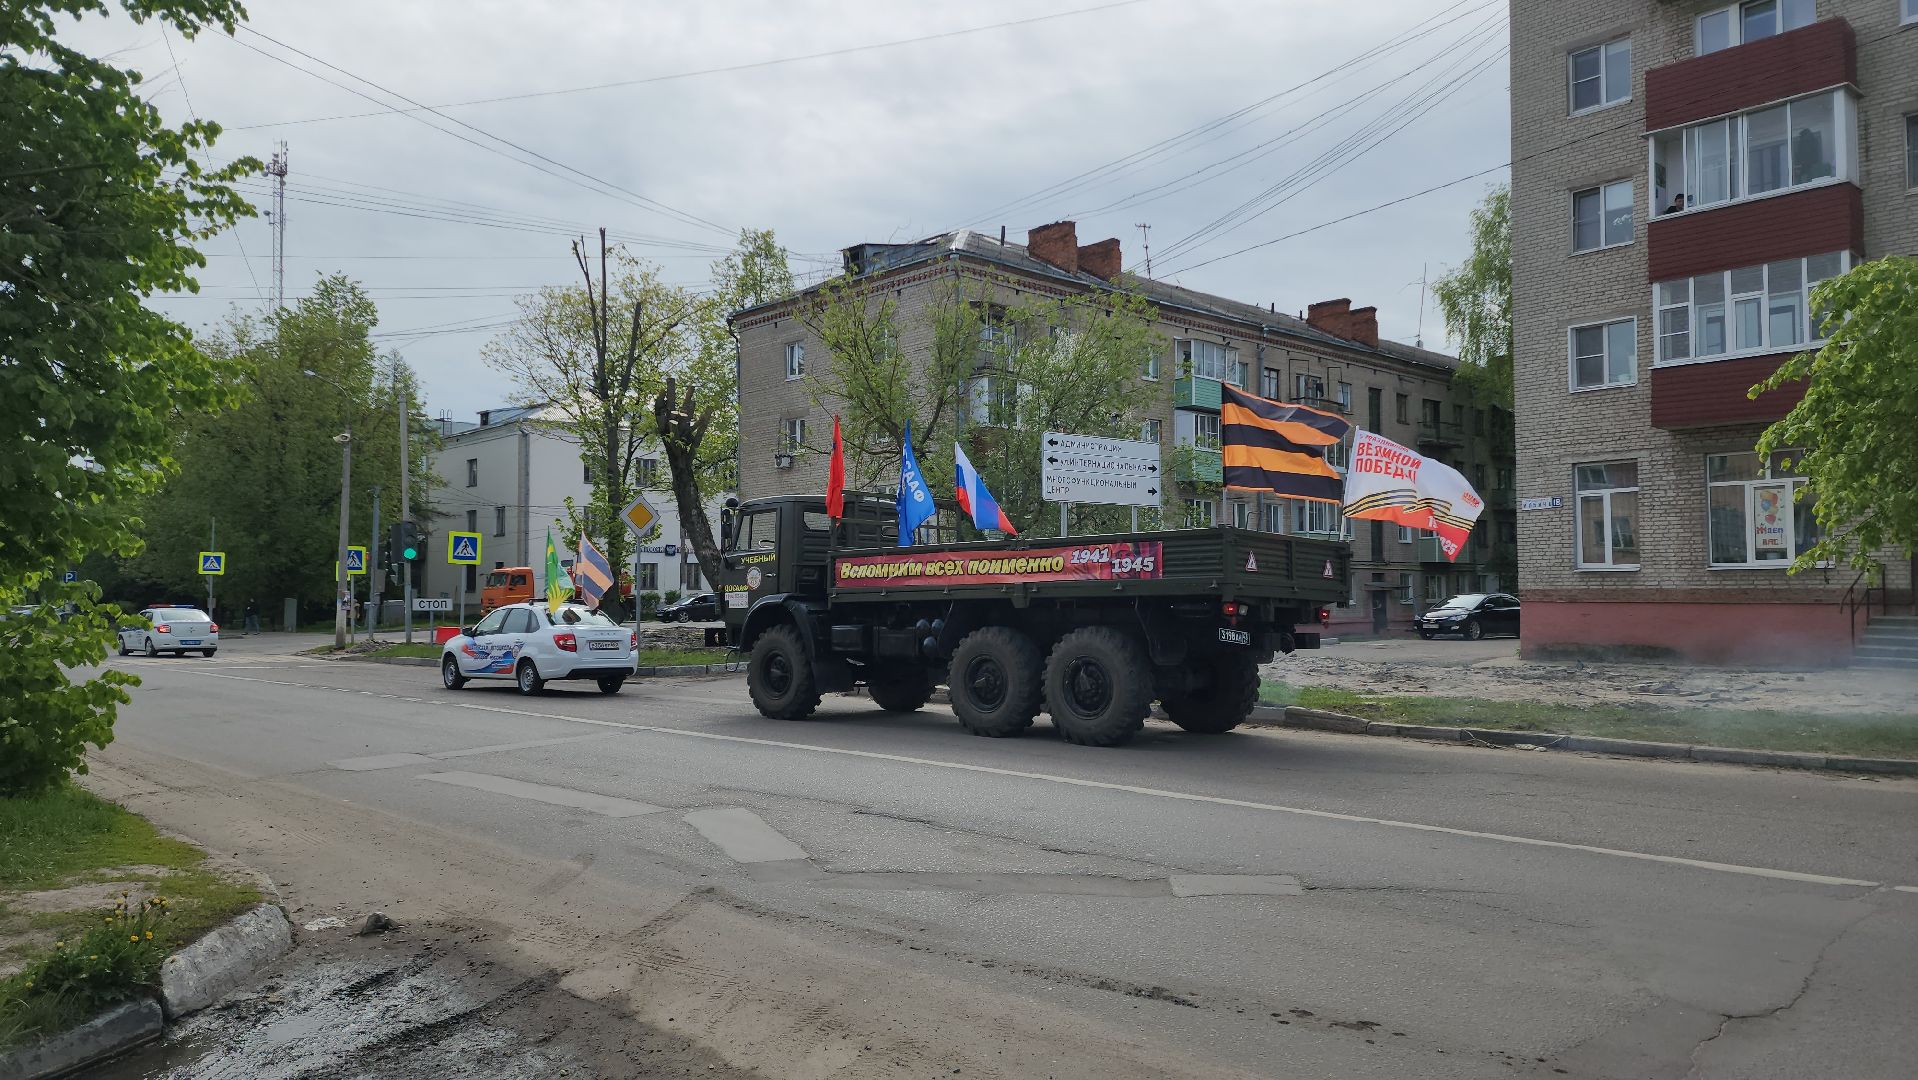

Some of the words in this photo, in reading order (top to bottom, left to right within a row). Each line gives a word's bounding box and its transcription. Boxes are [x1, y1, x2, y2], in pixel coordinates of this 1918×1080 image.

[1046, 486, 1070, 495] ЦЕНТР
[1553, 498, 1561, 506] 18
[740, 553, 776, 565] УЧЕБНЫЙ
[1071, 548, 1110, 564] 1941
[840, 561, 923, 579] Вспомним
[924, 558, 964, 576] всех
[967, 556, 1065, 576] поименно
[1111, 556, 1155, 573] 1945
[418, 600, 448, 609] СТОП
